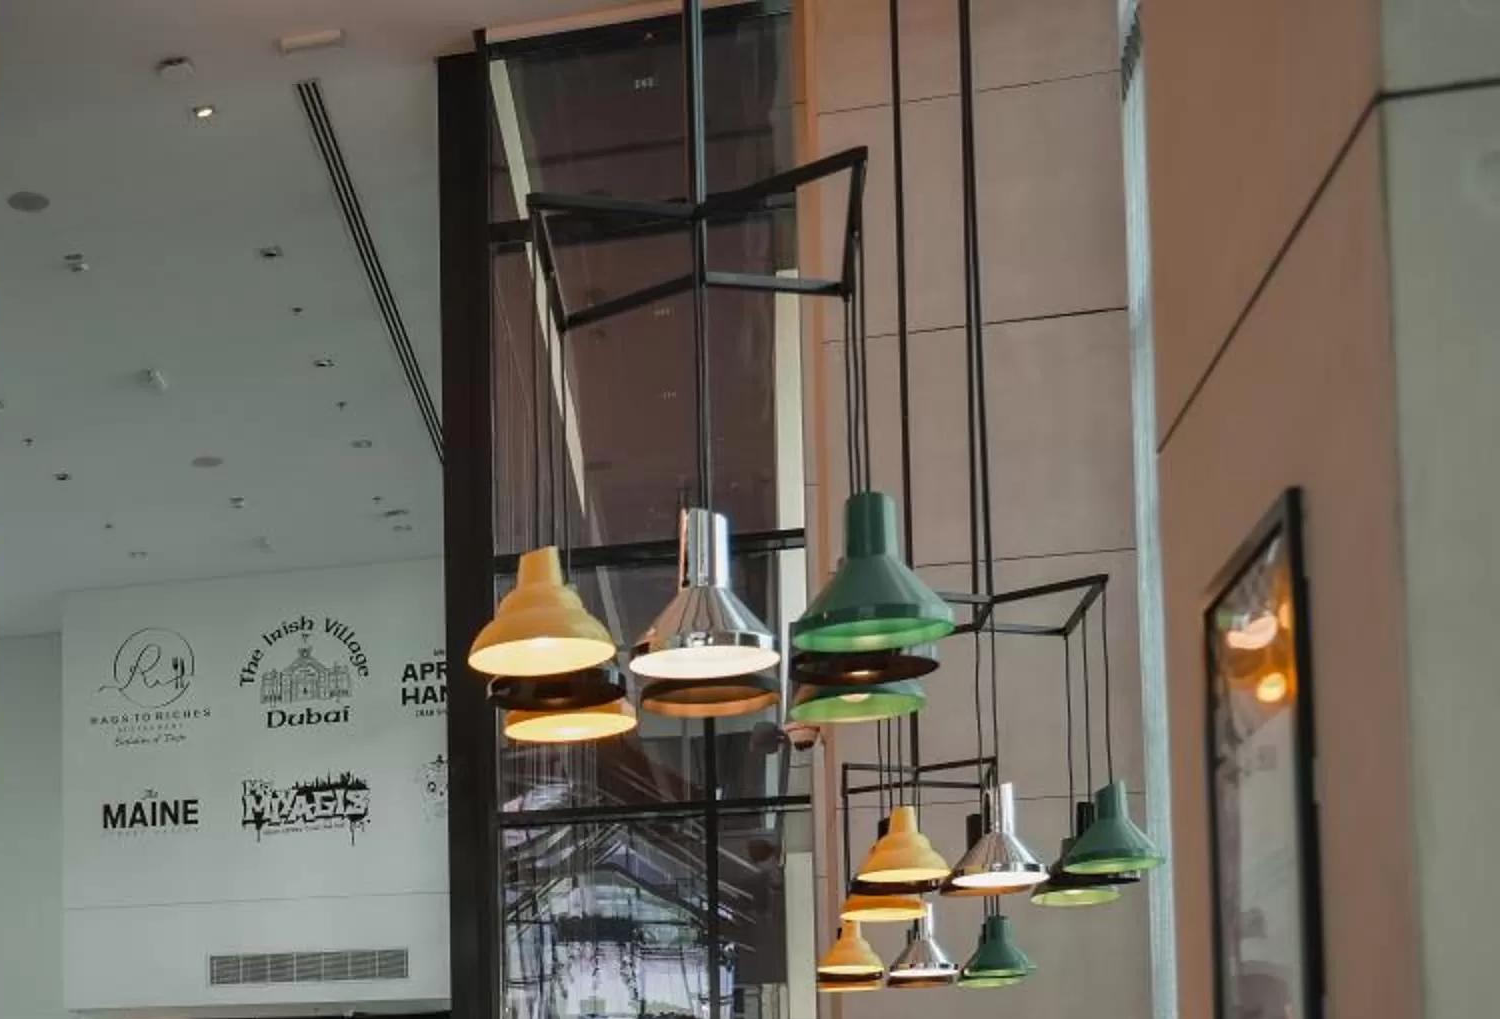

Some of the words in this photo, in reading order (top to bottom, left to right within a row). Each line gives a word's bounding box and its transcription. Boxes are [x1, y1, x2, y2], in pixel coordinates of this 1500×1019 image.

[239, 649, 264, 687] The
[262, 616, 314, 646] Irish
[324, 618, 369, 677] Village
[90, 713, 129, 725] RAGS
[134, 713, 151, 723] TO
[155, 708, 211, 721] RICHES
[267, 705, 351, 728] Dubai
[103, 799, 199, 828] MAINE
